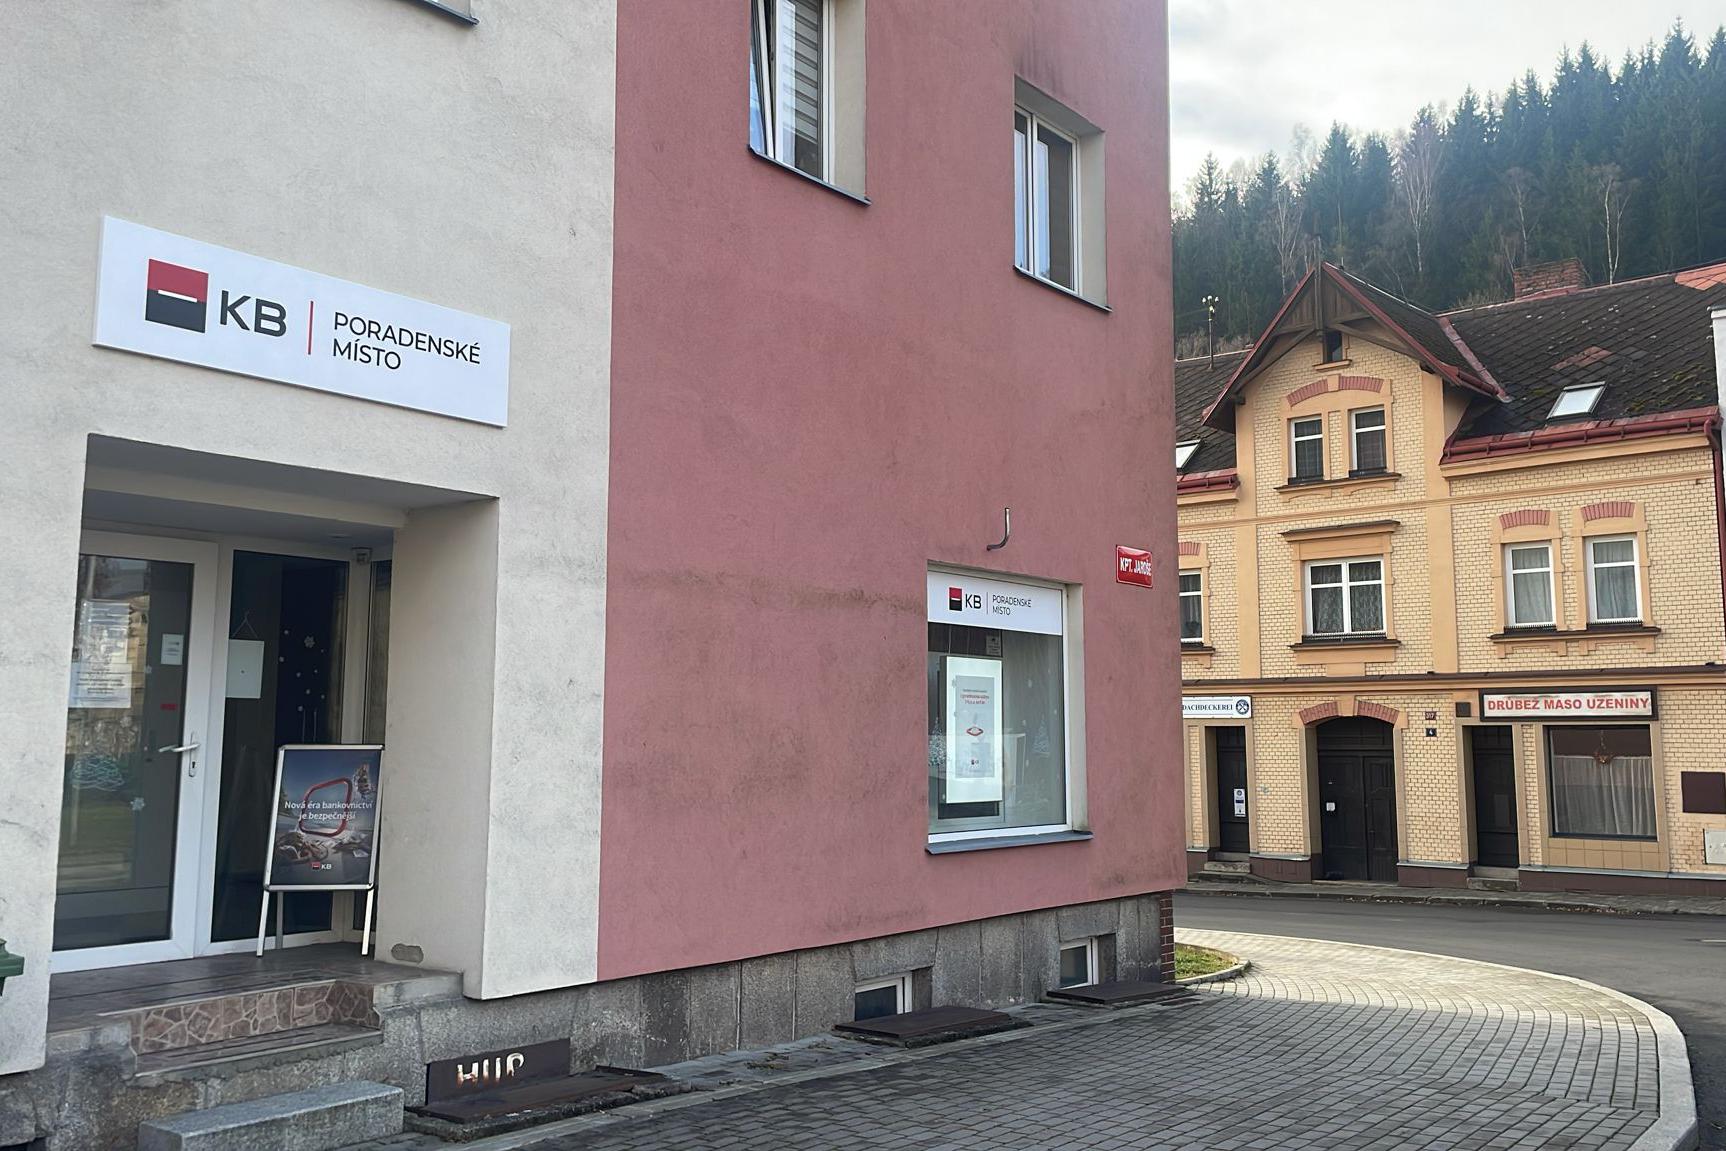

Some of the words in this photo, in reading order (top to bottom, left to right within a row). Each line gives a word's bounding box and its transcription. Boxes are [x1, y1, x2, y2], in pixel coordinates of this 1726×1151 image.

[219, 290, 287, 337] KB
[334, 311, 481, 365] PORADENSKÉ
[333, 338, 401, 370] MÍSTO
[1120, 556, 1133, 573] KPT.
[965, 593, 982, 609] KB
[1544, 698, 1582, 710] MASO
[1586, 697, 1649, 710] UZENINY
[284, 800, 306, 809] Nová
[307, 800, 320, 809] éra
[322, 800, 373, 809] bankovnictví
